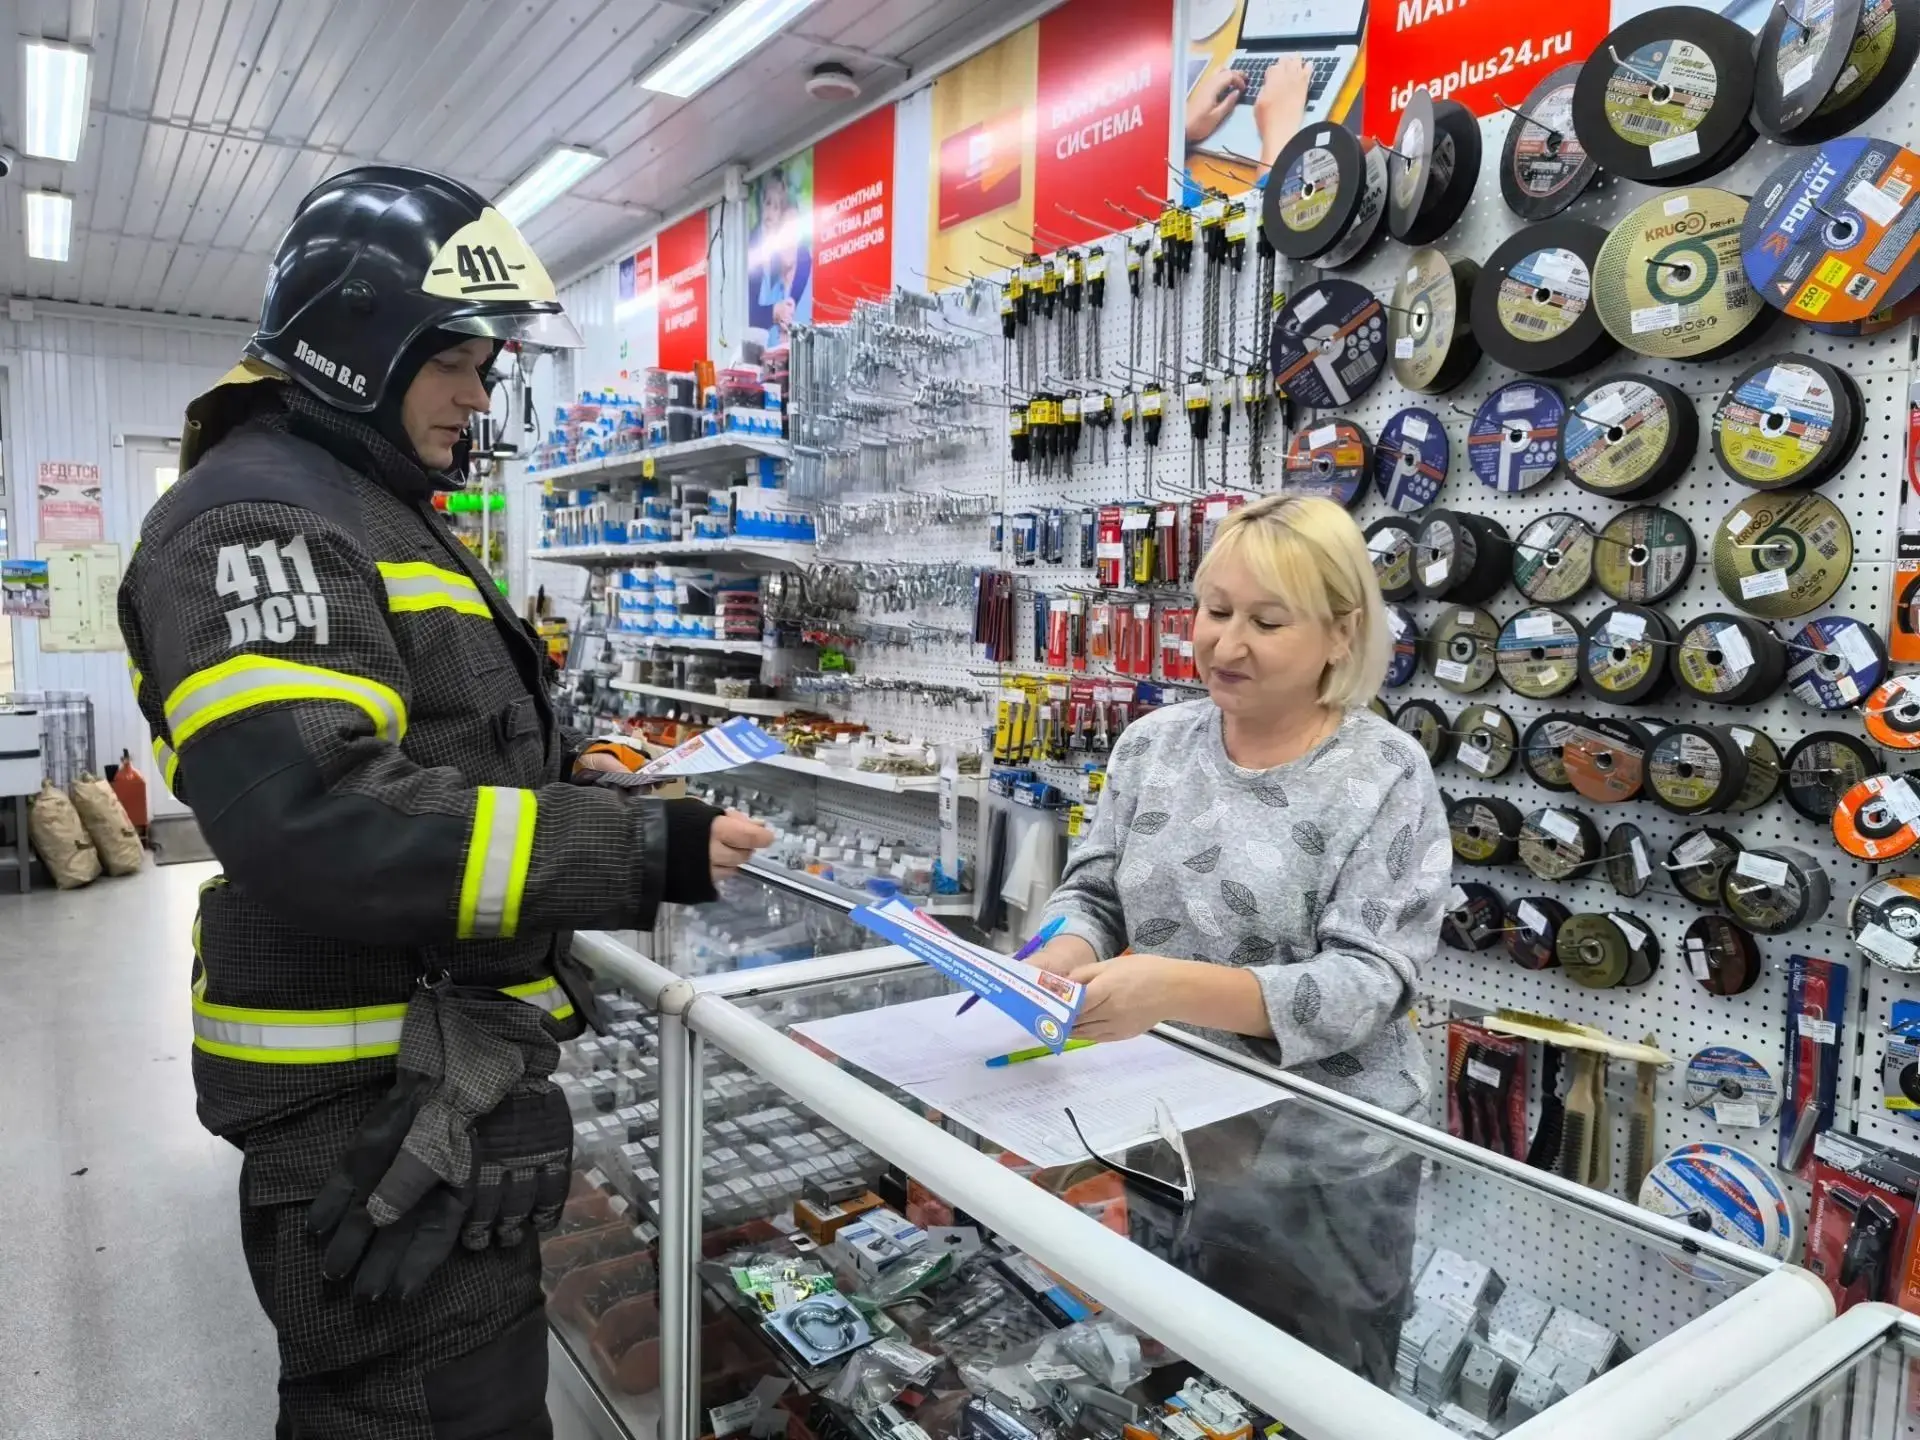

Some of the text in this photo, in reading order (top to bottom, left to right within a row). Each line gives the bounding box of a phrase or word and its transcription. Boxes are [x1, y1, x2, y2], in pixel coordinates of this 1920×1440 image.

[1056, 104, 1144, 160] СИСТЕМА
[862, 203, 884, 228] ДЛЯ
[1779, 160, 1838, 234] РОКОТ
[818, 226, 886, 266] ПЕНСИОНЕРОВ
[1645, 211, 1706, 242] KRUGO
[456, 243, 510, 284] 411
[1798, 286, 1819, 307] 230
[294, 339, 368, 399] Лапа В.С.
[40, 462, 99, 480] ВЕДЕТСЯ
[1736, 509, 1774, 545] KRUGO
[216, 535, 321, 602] 411
[1847, 1167, 1900, 1195] АТРИКС
[1811, 1198, 1826, 1254] ЗАКЛЕПОЧНИК
